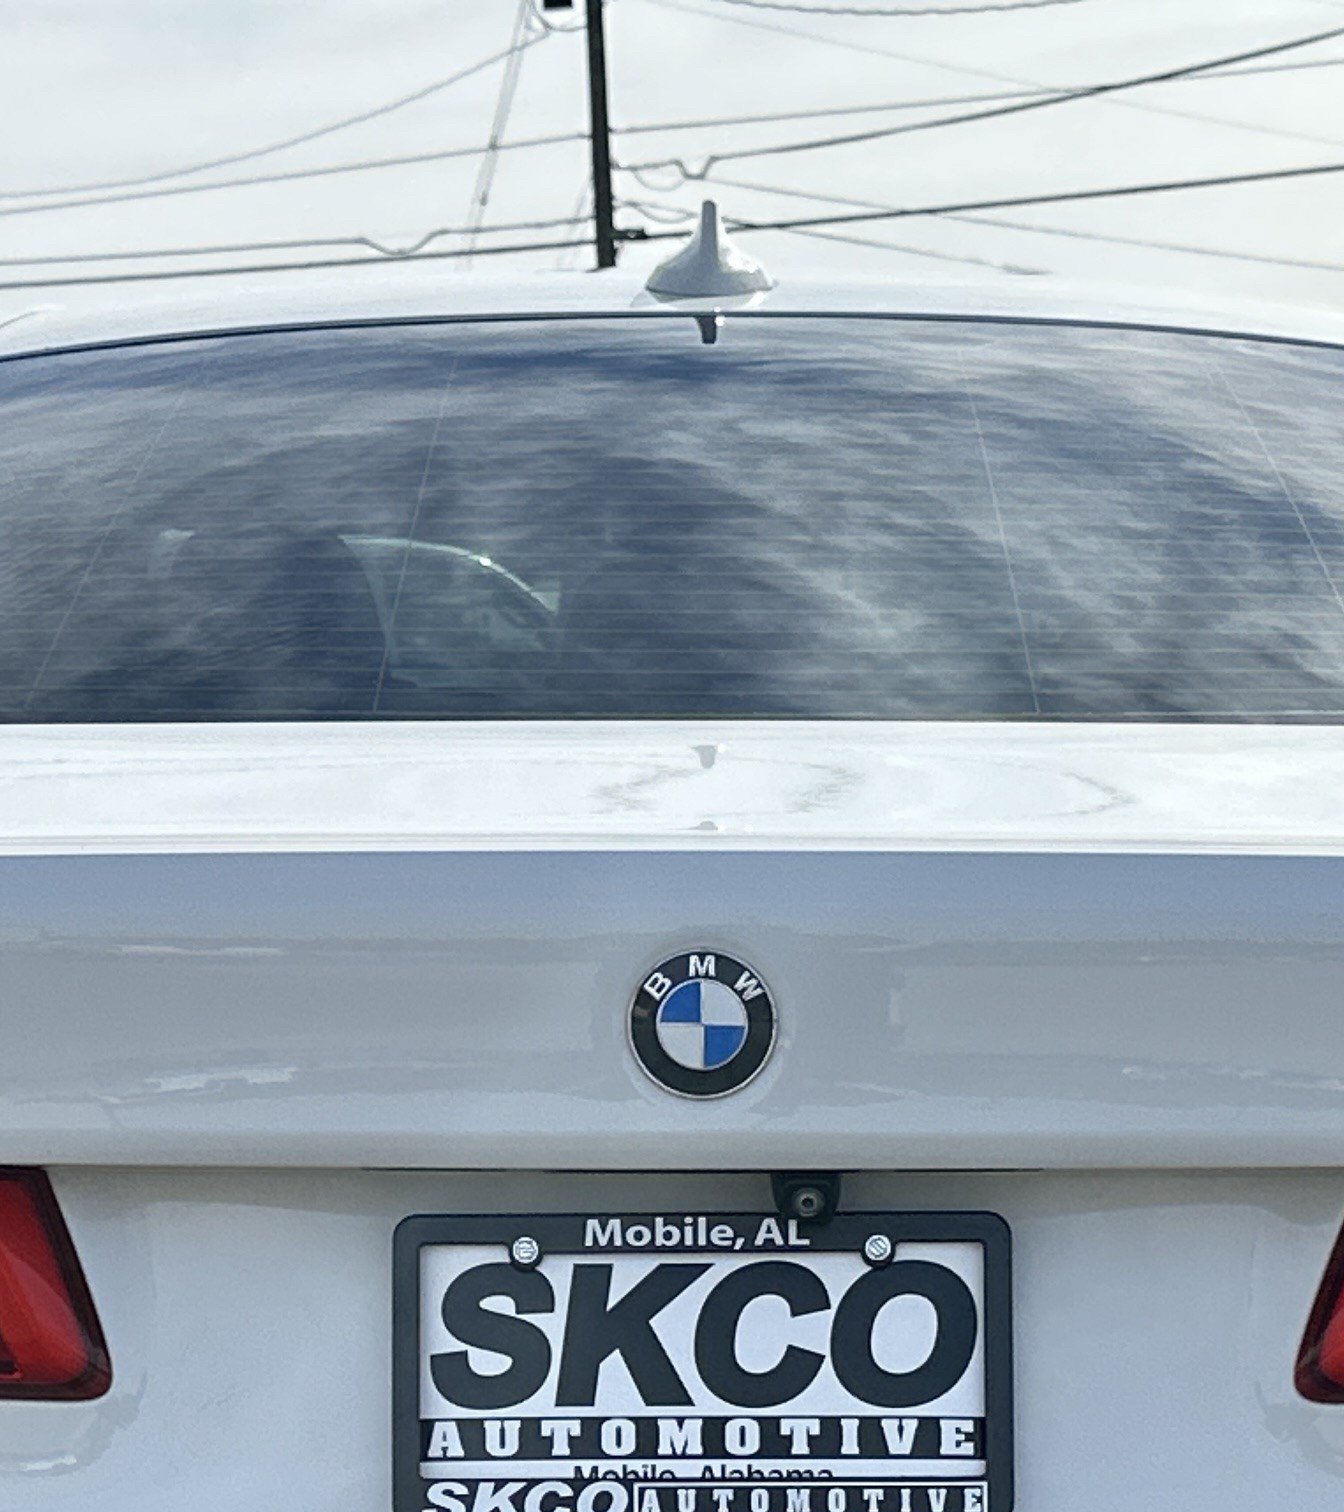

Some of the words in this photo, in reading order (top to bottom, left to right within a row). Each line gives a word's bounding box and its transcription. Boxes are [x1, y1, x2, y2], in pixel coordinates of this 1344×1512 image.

[643, 954, 765, 1002] BMW
[583, 1216, 744, 1250] Mobile,
[754, 1218, 811, 1247] AL
[430, 1260, 978, 1410] SKCO
[427, 1418, 976, 1459] AUTOMOTIVE
